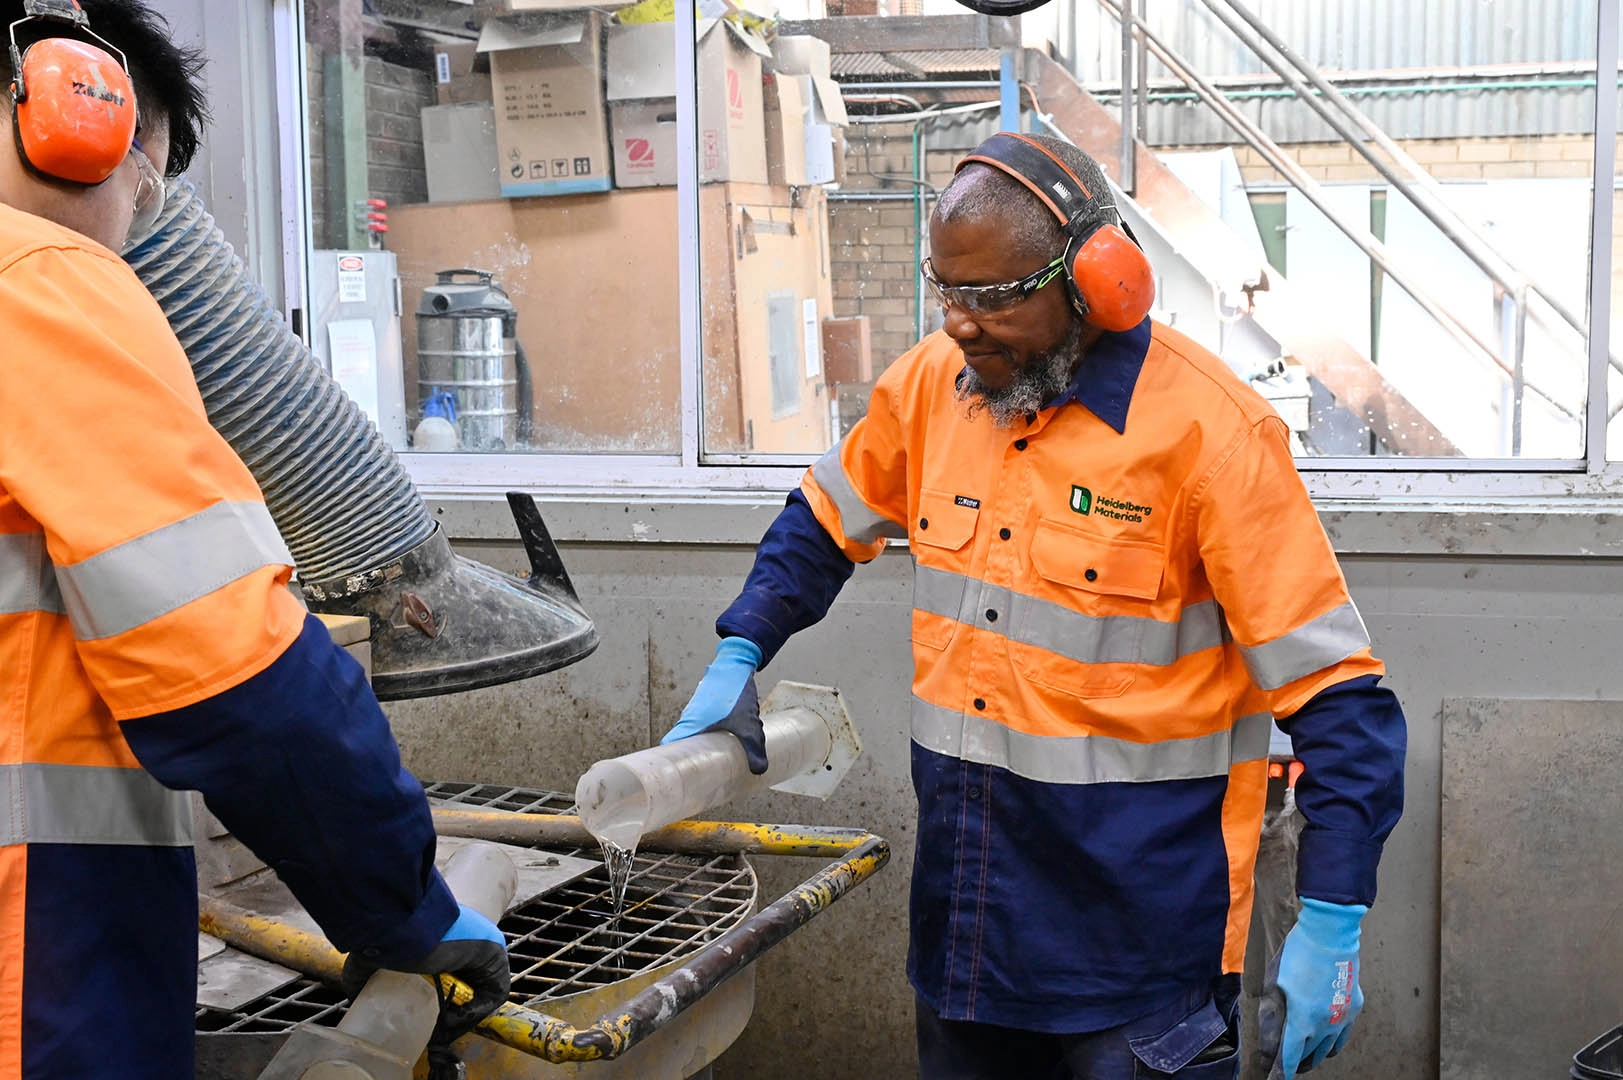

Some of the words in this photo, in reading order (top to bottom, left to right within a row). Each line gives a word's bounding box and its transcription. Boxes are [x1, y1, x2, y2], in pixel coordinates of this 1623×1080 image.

[1023, 278, 1038, 291] PRO
[1096, 495, 1152, 516] Heidelberg
[1094, 506, 1142, 523] Materials
